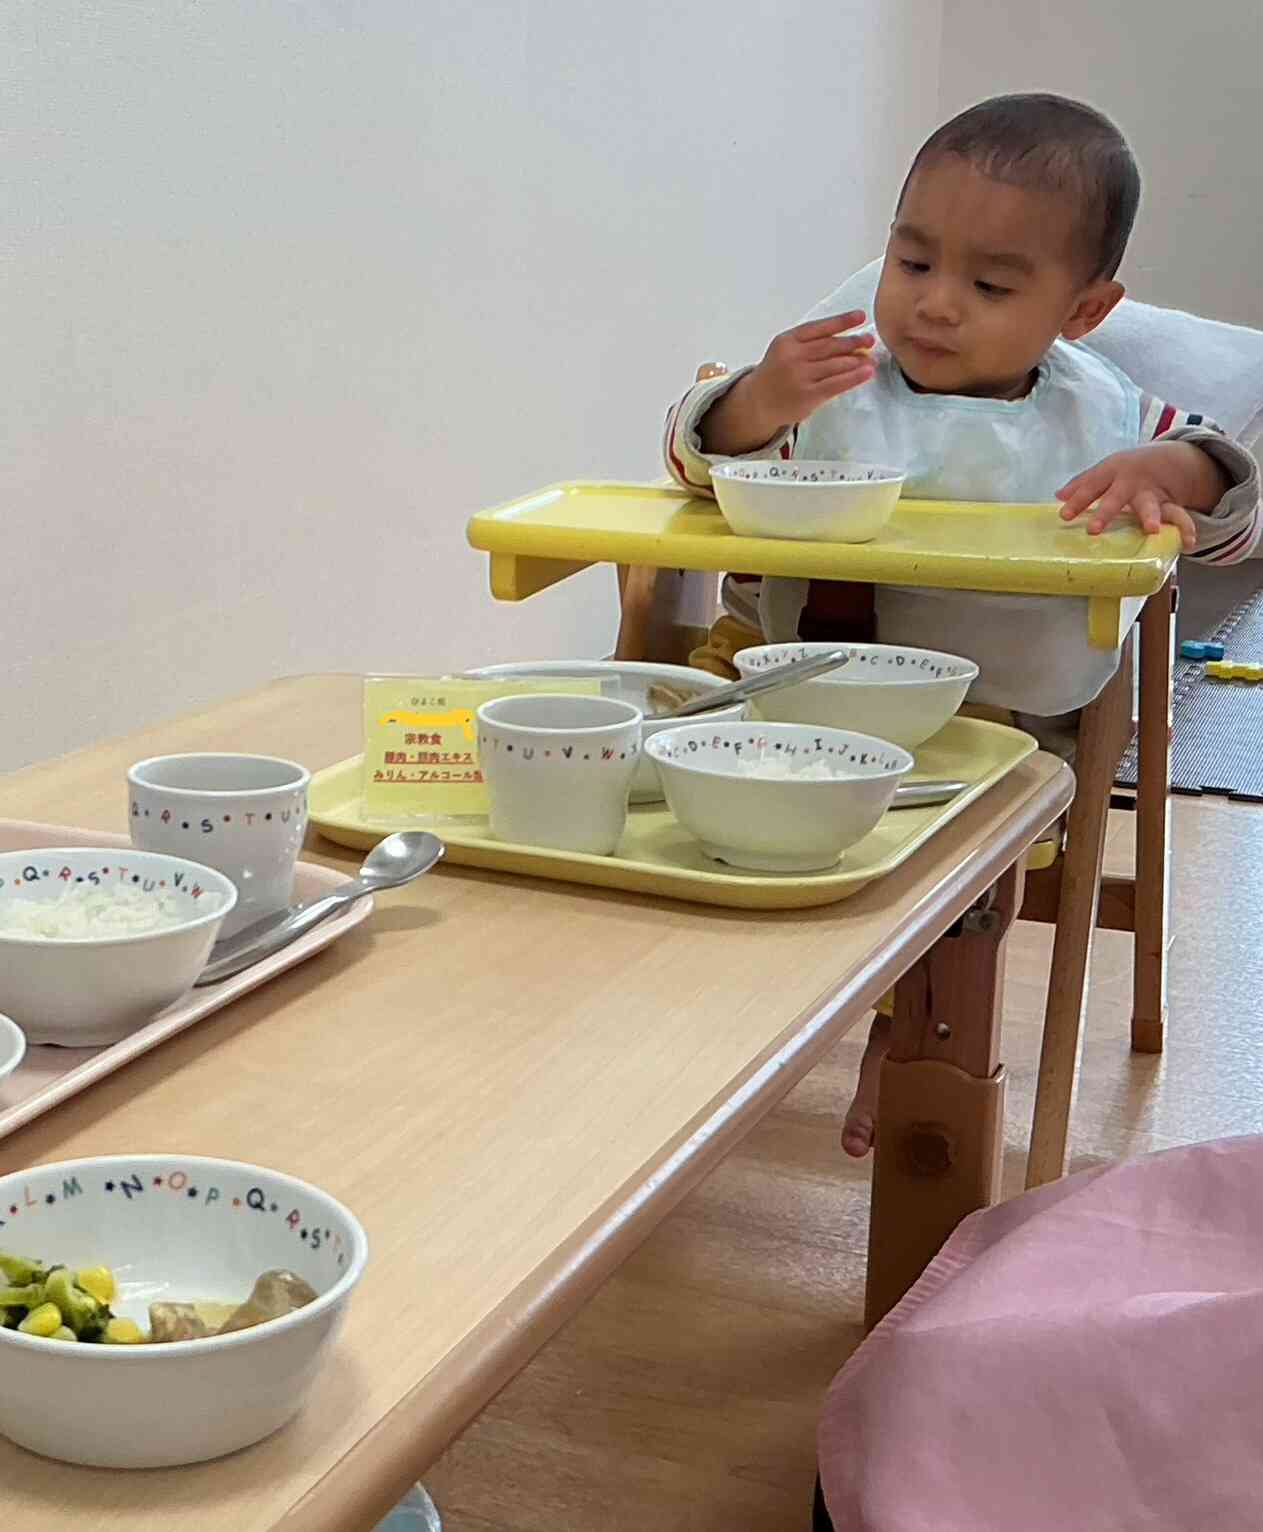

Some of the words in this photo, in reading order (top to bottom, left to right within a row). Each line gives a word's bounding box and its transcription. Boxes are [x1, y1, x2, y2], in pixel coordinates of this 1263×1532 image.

[711, 735, 721, 750] E
[561, 745, 573, 759] V
[200, 818, 213, 833] S
[22, 865, 40, 882] Q
[87, 871, 101, 886] S
[118, 866, 129, 881] T
[142, 879, 156, 893] U
[173, 871, 185, 888] V
[24, 1184, 38, 1207] L
[62, 1175, 84, 1199] M
[119, 1173, 144, 1200] N
[168, 1171, 188, 1191] O
[204, 1186, 220, 1206] P
[246, 1187, 265, 1212] Q
[310, 1226, 322, 1250] S
